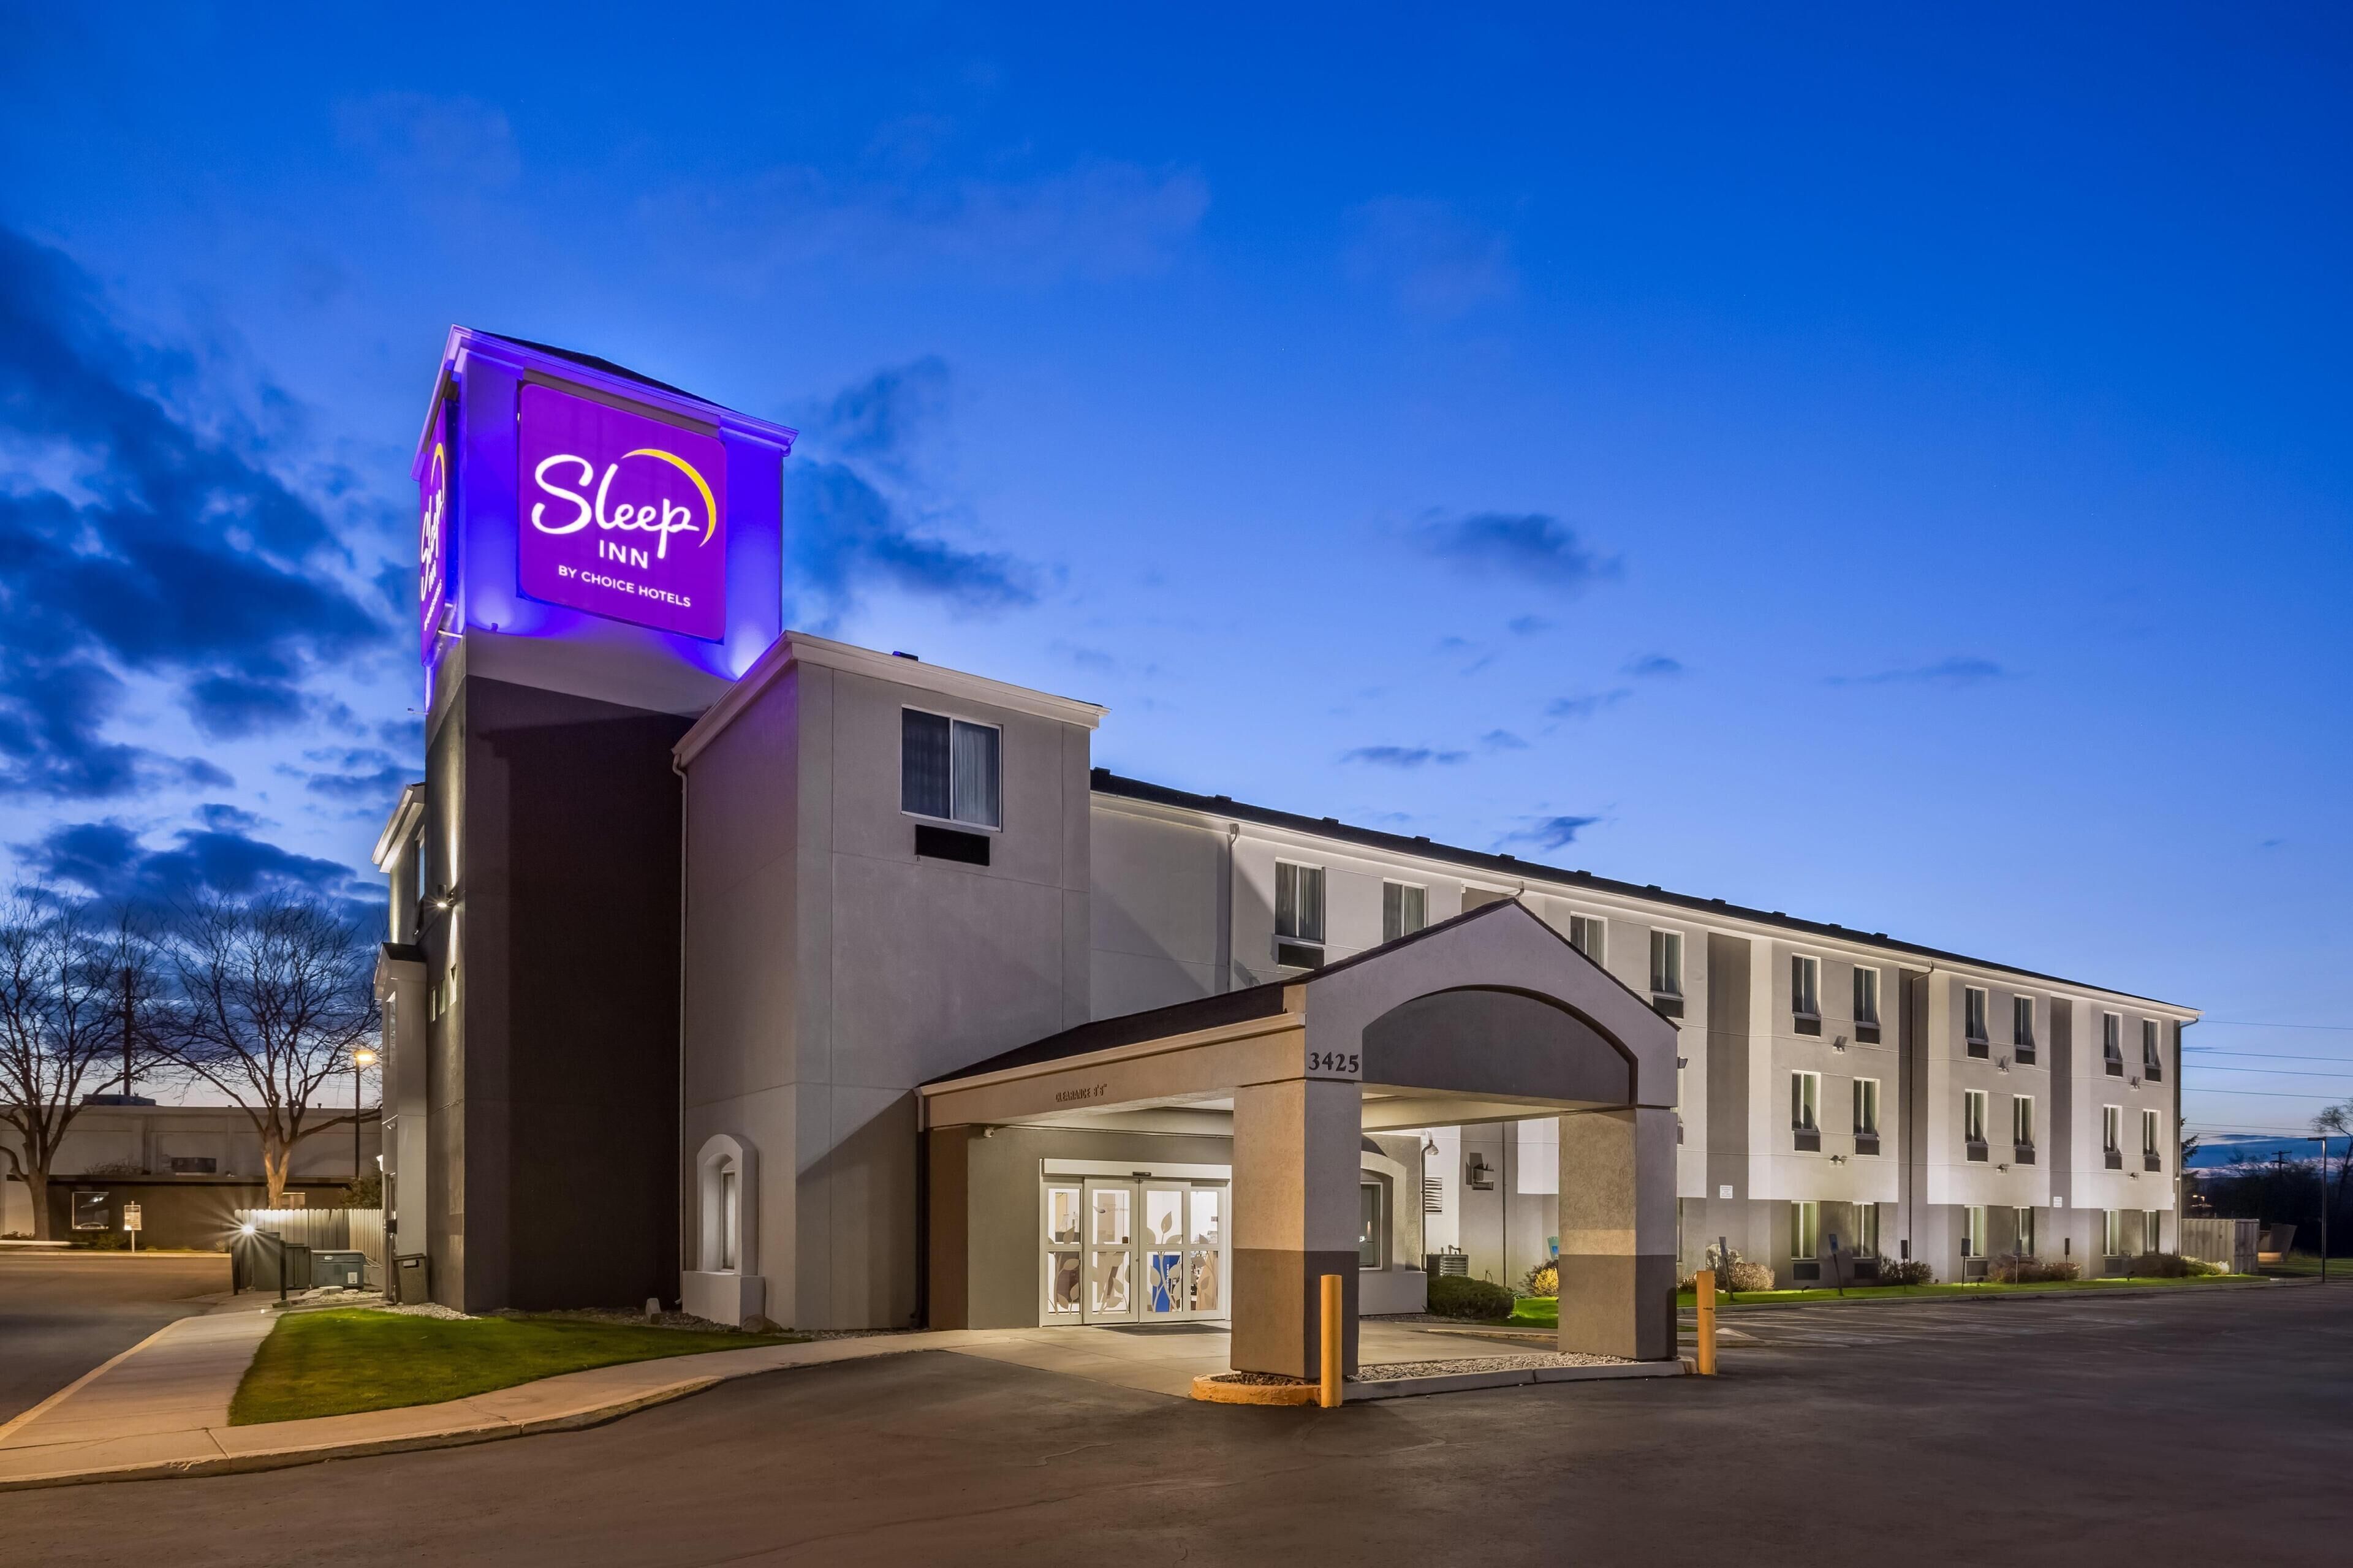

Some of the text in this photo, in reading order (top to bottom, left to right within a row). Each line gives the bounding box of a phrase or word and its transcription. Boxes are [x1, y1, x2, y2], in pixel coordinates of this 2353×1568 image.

[531, 454, 700, 559] Sleep
[599, 540, 648, 569] INN
[558, 564, 691, 608] BY CHOICE HOTELS
[1308, 1051, 1359, 1074] 3425
[1055, 1088, 1091, 1103] CLEARANCE
